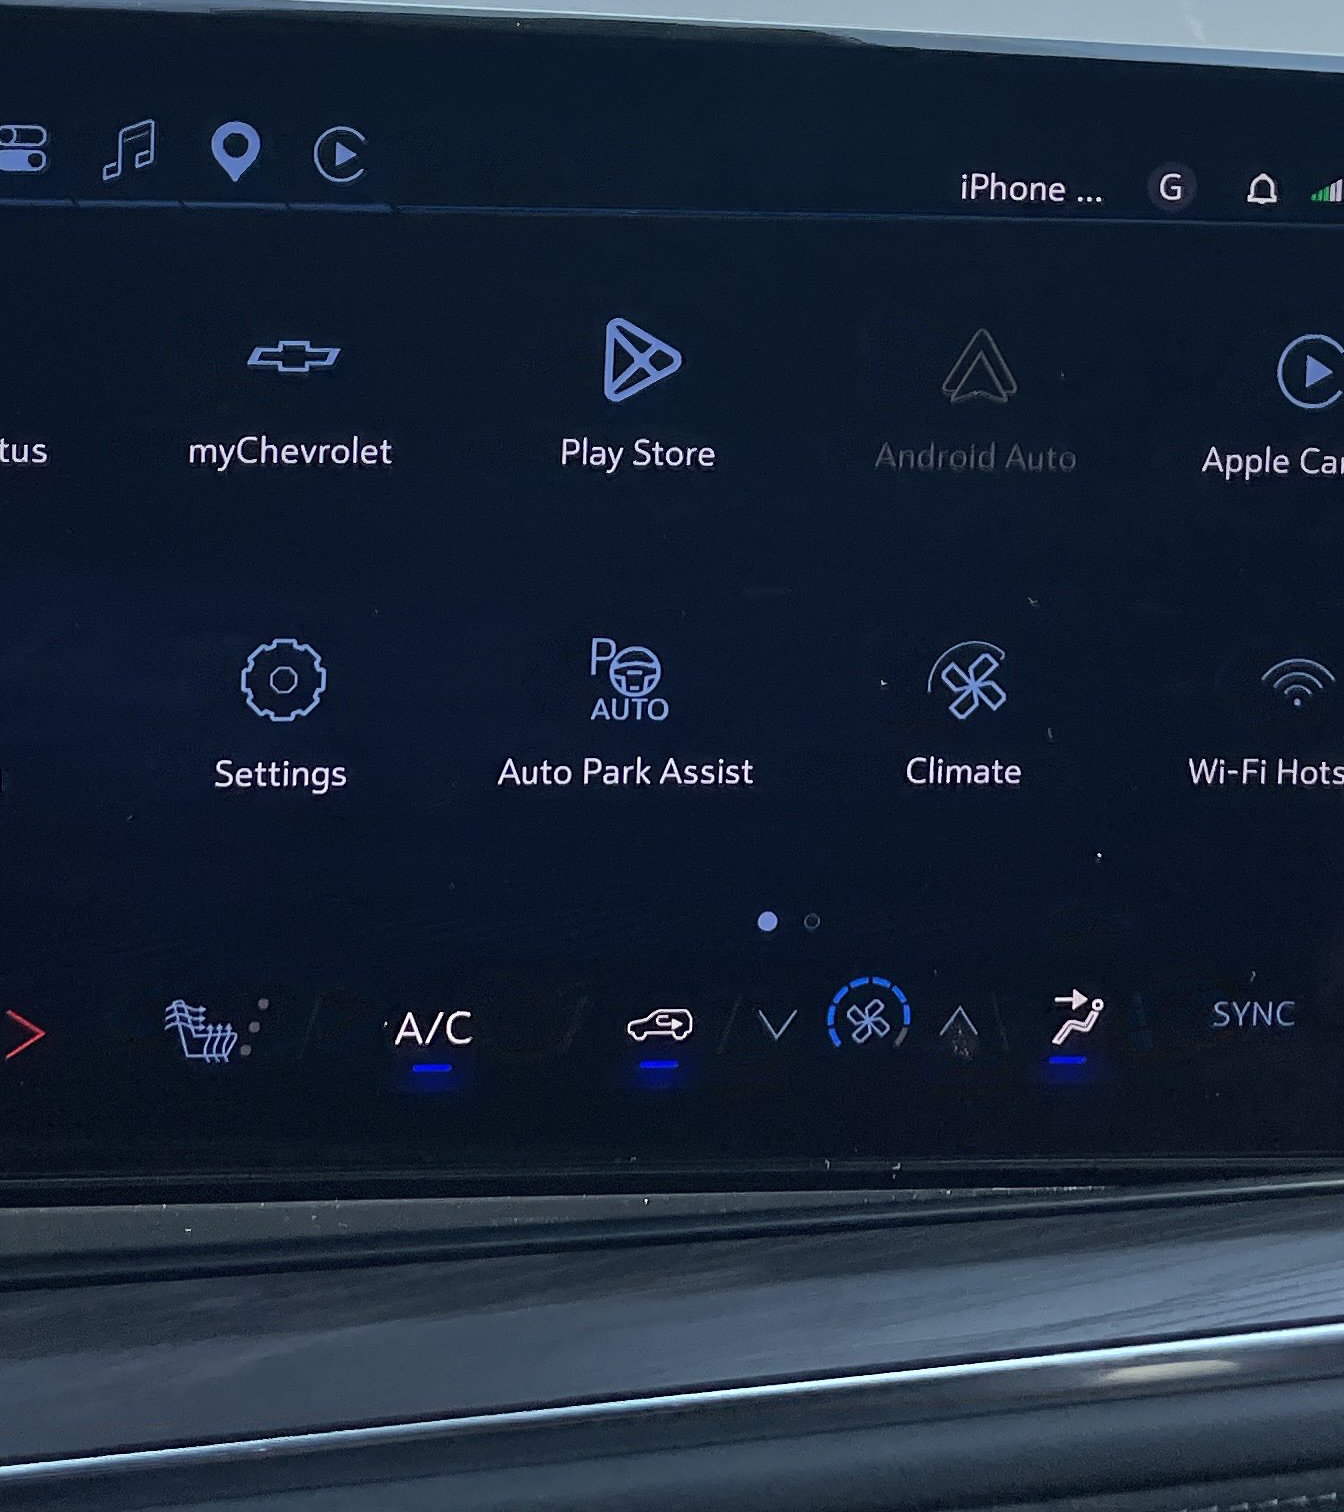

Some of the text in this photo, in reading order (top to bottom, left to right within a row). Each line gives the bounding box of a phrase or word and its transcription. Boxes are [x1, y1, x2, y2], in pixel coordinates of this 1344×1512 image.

[961, 172, 1066, 202] iPhone
[1159, 173, 1182, 201] G
[189, 434, 393, 472] myChevrolet
[561, 436, 716, 474] Play Store
[874, 441, 1077, 472] Android Auto
[1201, 445, 1290, 481] Apple
[590, 637, 618, 676] P
[590, 695, 669, 721] AUTO
[214, 759, 347, 795] Settings
[497, 756, 754, 786] Auto Park Assist
[906, 755, 1022, 784] Climate
[1188, 757, 1267, 785] Wi-Fi
[394, 1010, 473, 1046] A/C
[1213, 1000, 1295, 1027] SYNC
